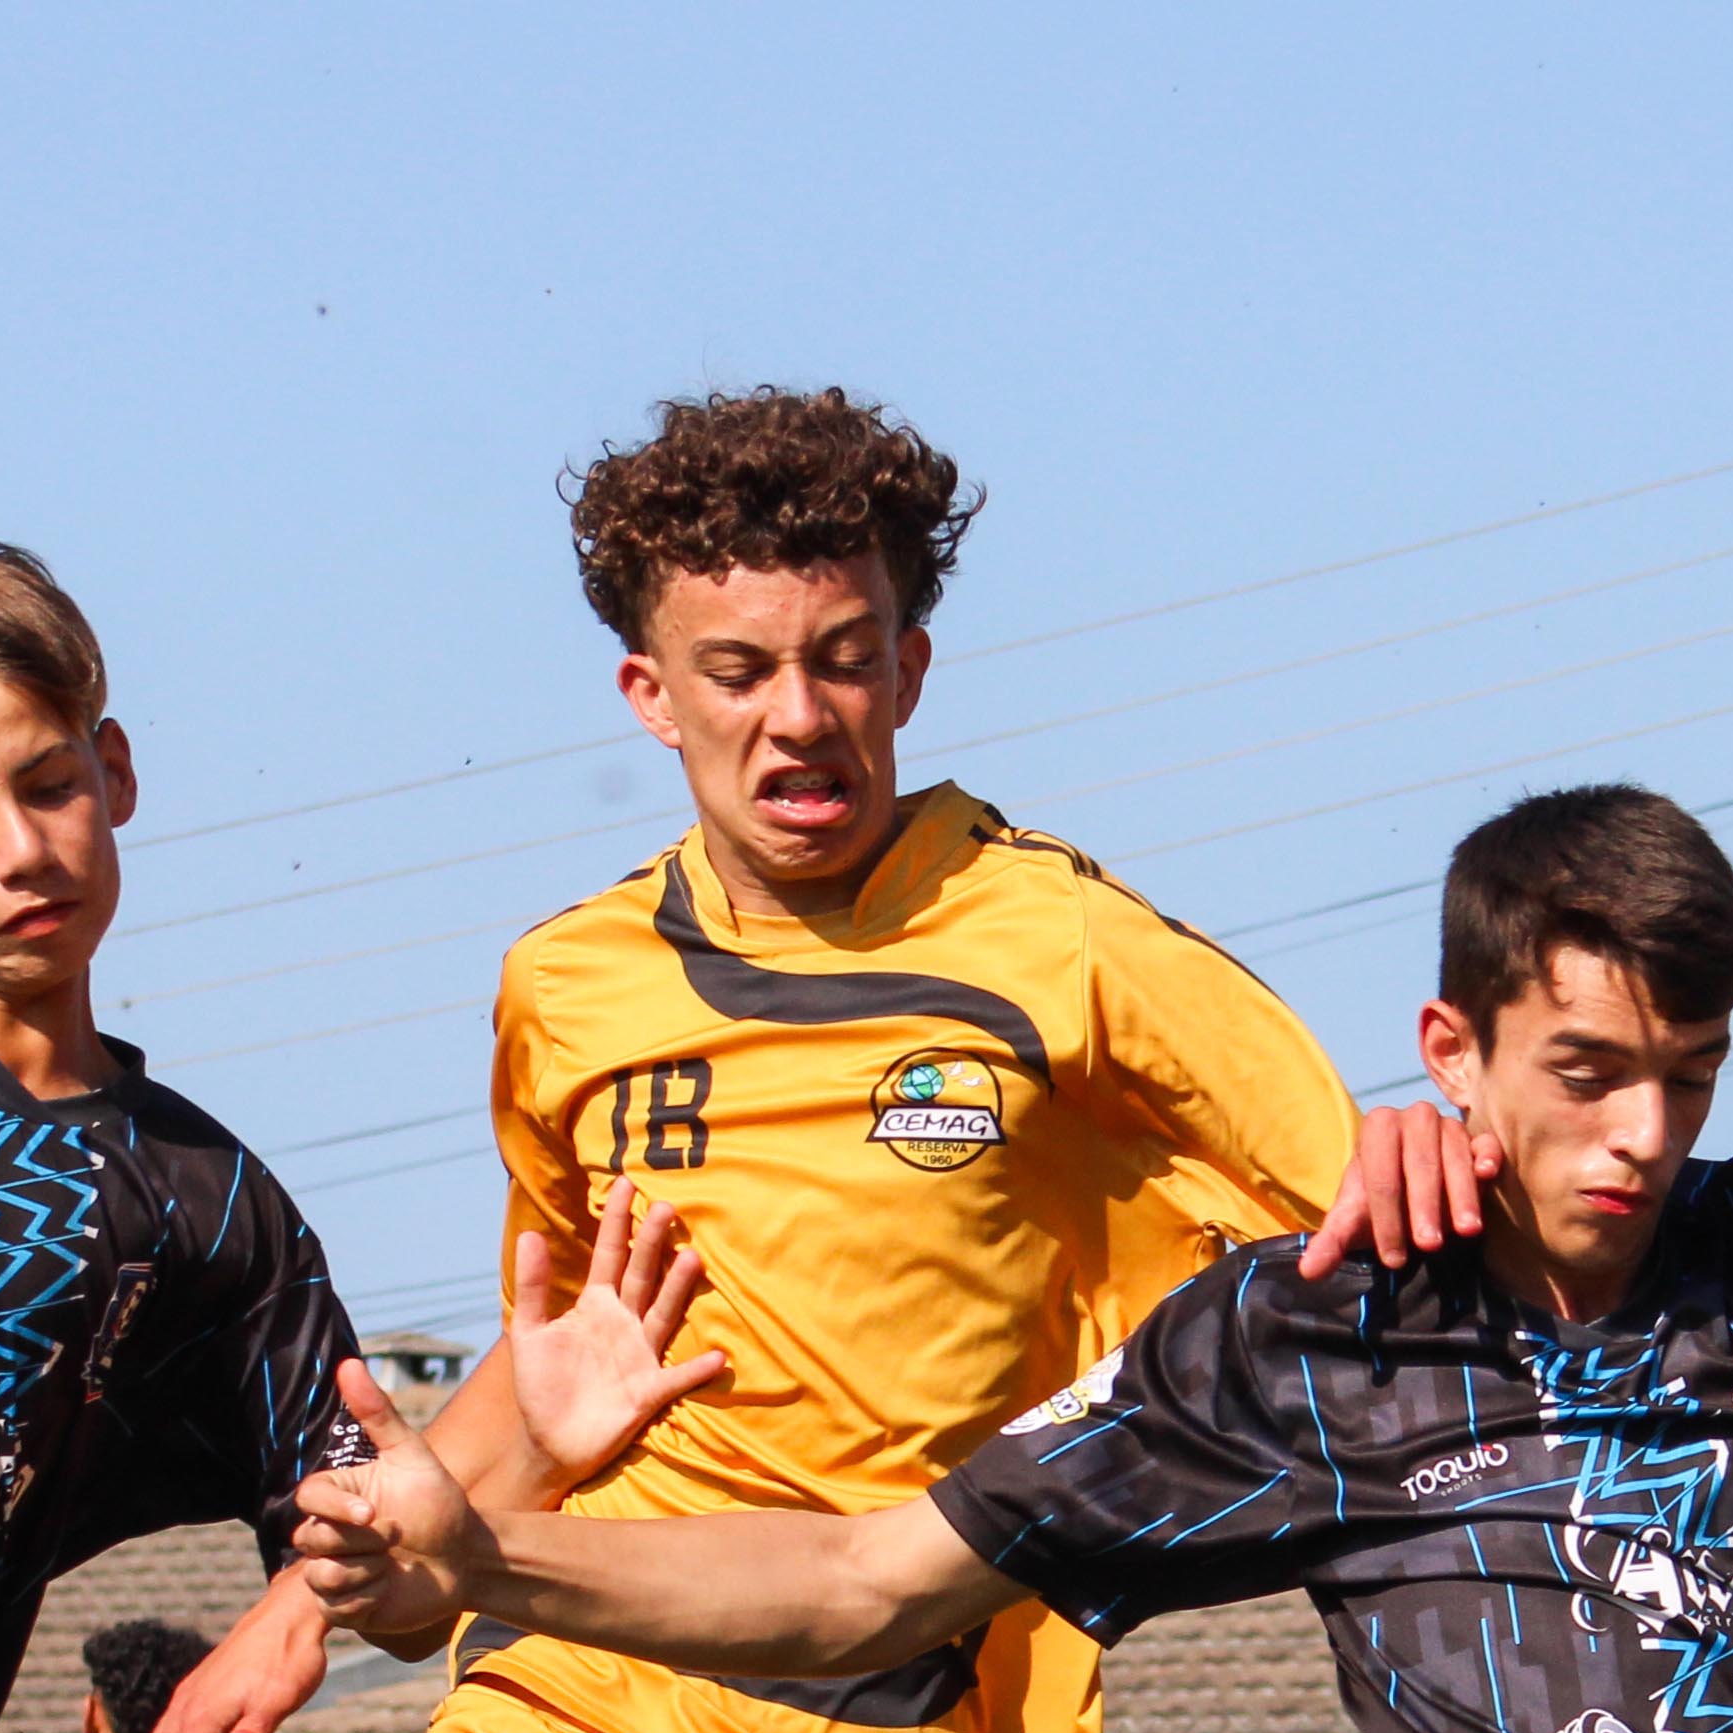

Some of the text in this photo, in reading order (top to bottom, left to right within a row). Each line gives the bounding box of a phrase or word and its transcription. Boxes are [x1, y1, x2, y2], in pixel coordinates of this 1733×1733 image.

[609, 1057, 712, 1174] 18
[883, 1112, 990, 1137] CEMAG
[907, 1142, 969, 1154] RESERVA
[922, 1155, 953, 1166] 1960
[1399, 1443, 1509, 1502] TOQUIO
